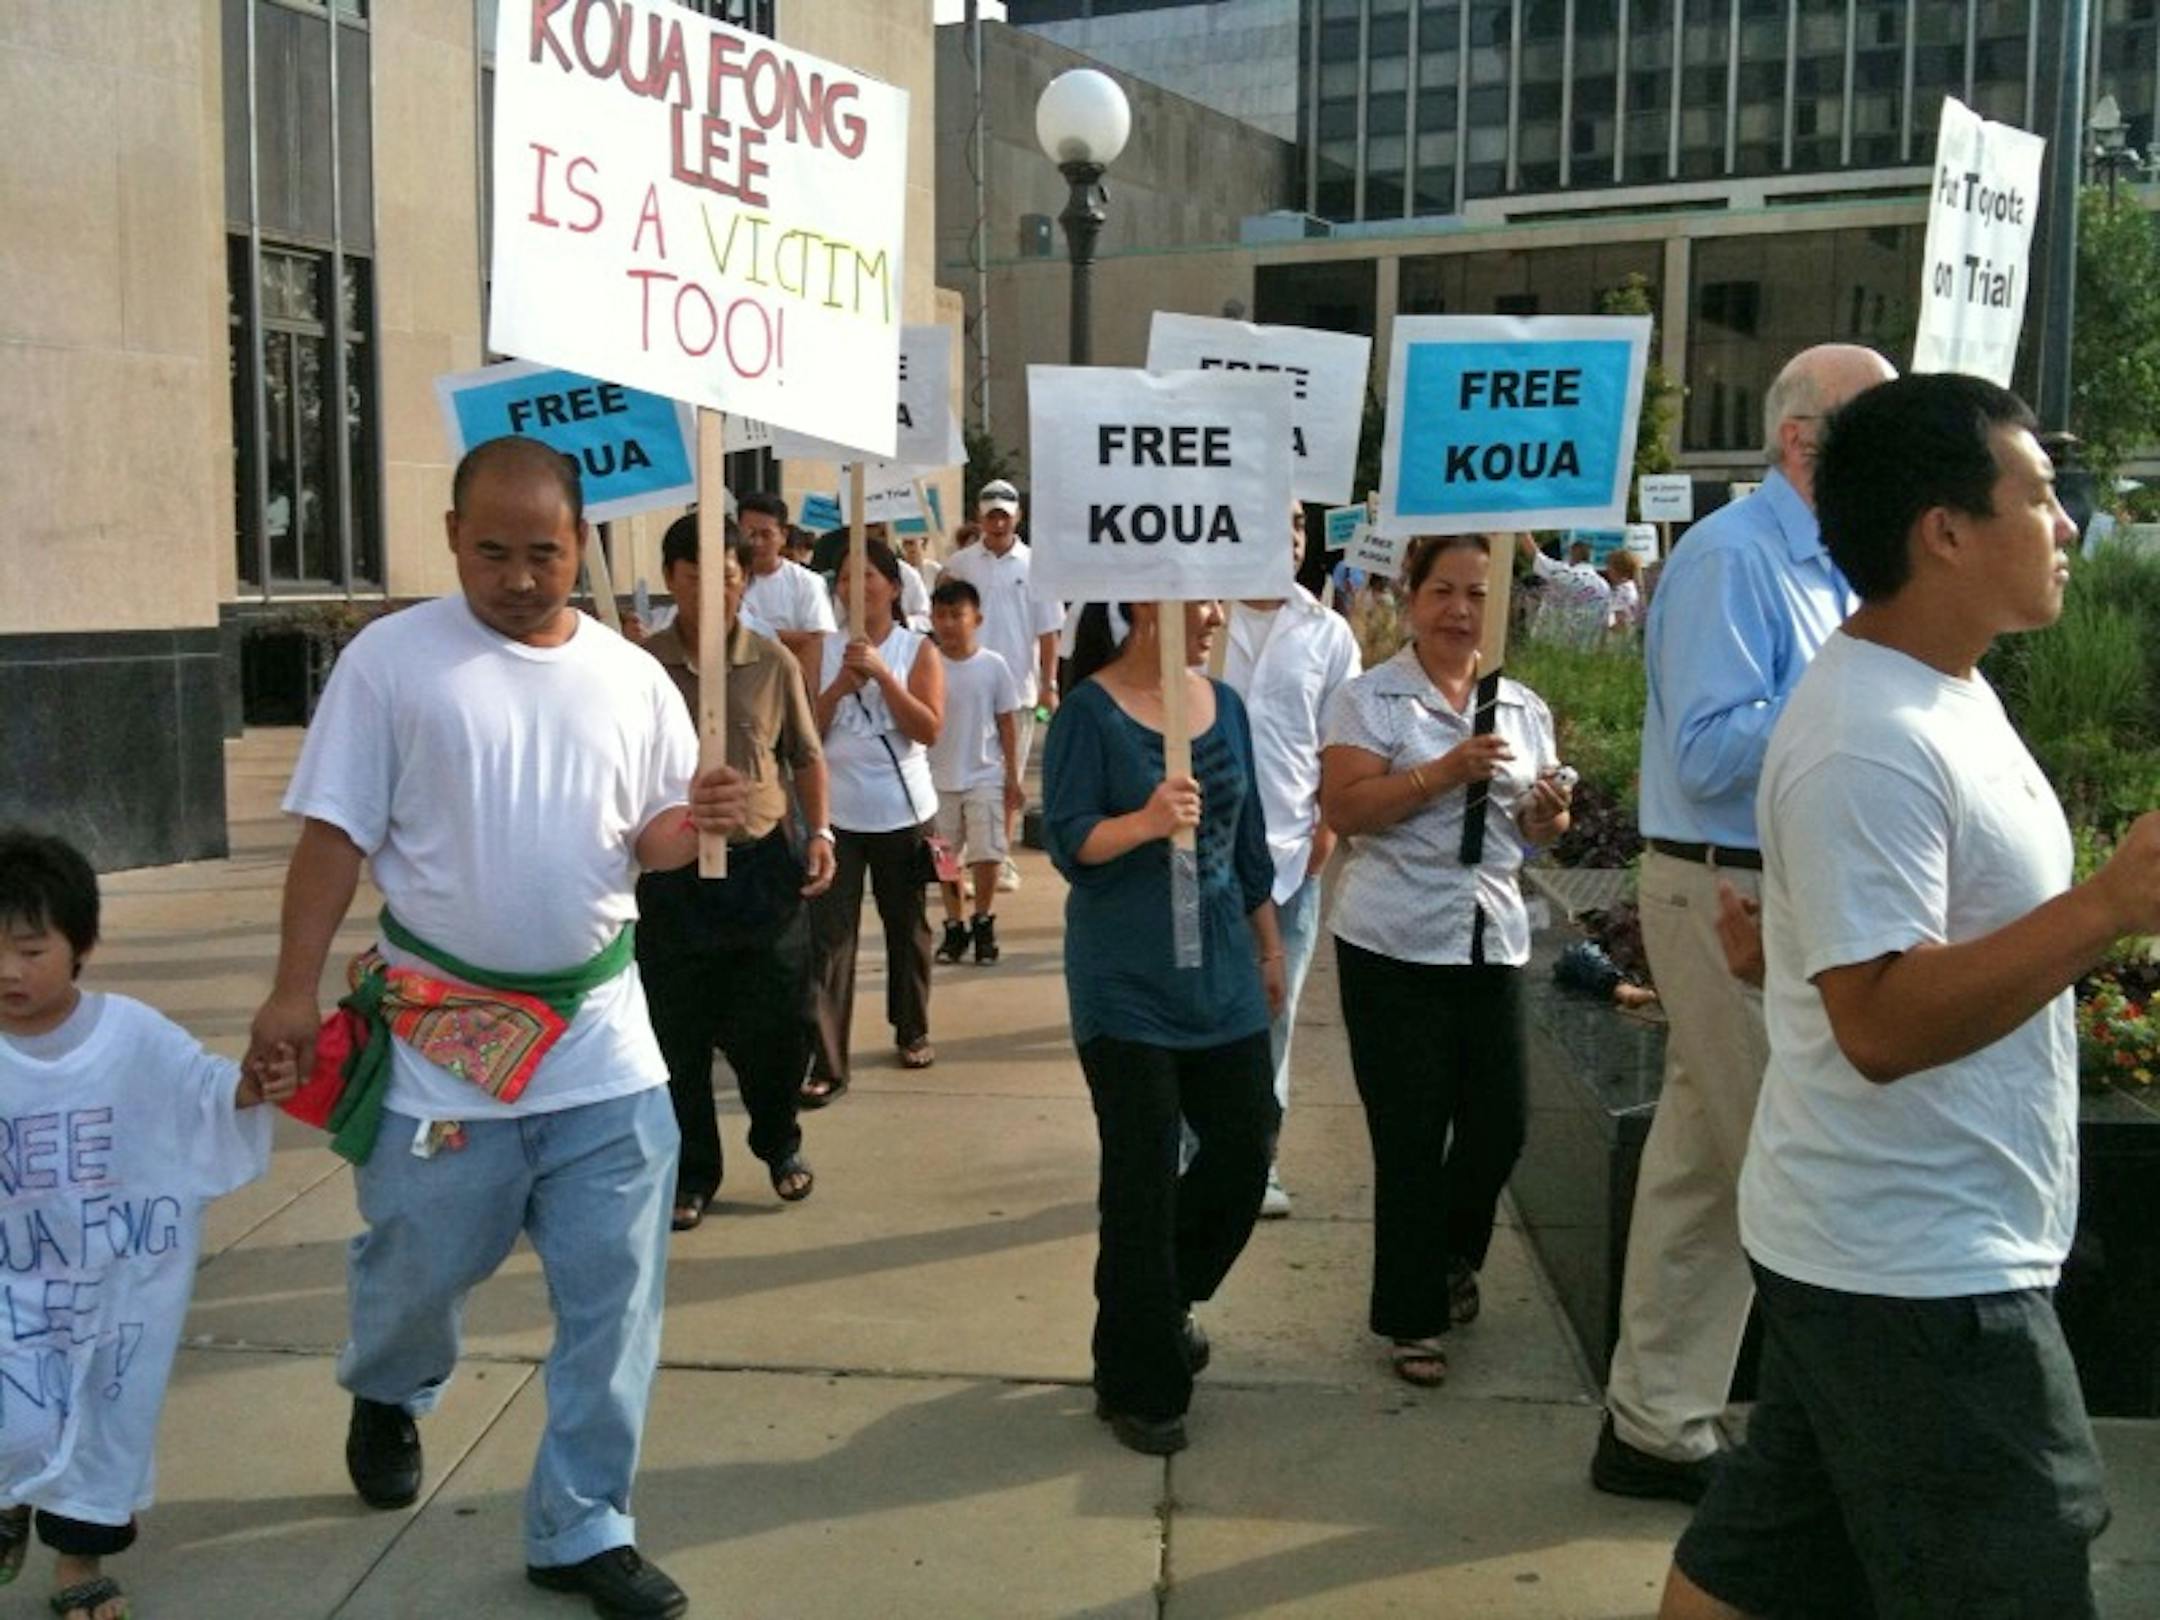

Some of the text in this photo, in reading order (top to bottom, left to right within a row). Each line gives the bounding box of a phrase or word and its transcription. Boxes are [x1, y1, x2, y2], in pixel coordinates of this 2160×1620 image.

[530, 0, 868, 159] KOUA FONG
[670, 104, 770, 208] LEE
[528, 142, 890, 323] IS A VICTIM
[1964, 253, 2015, 309] Trial
[626, 269, 784, 386] TOO!
[507, 382, 628, 432] FREE
[1458, 369, 1583, 410] FREE
[572, 438, 653, 477] UA
[1098, 424, 1232, 467] FREE
[1444, 440, 1581, 483] KOUA
[1088, 504, 1242, 544] KOUA
[81, 1193, 181, 1270] FONG
[5, 1279, 103, 1345] LEE
